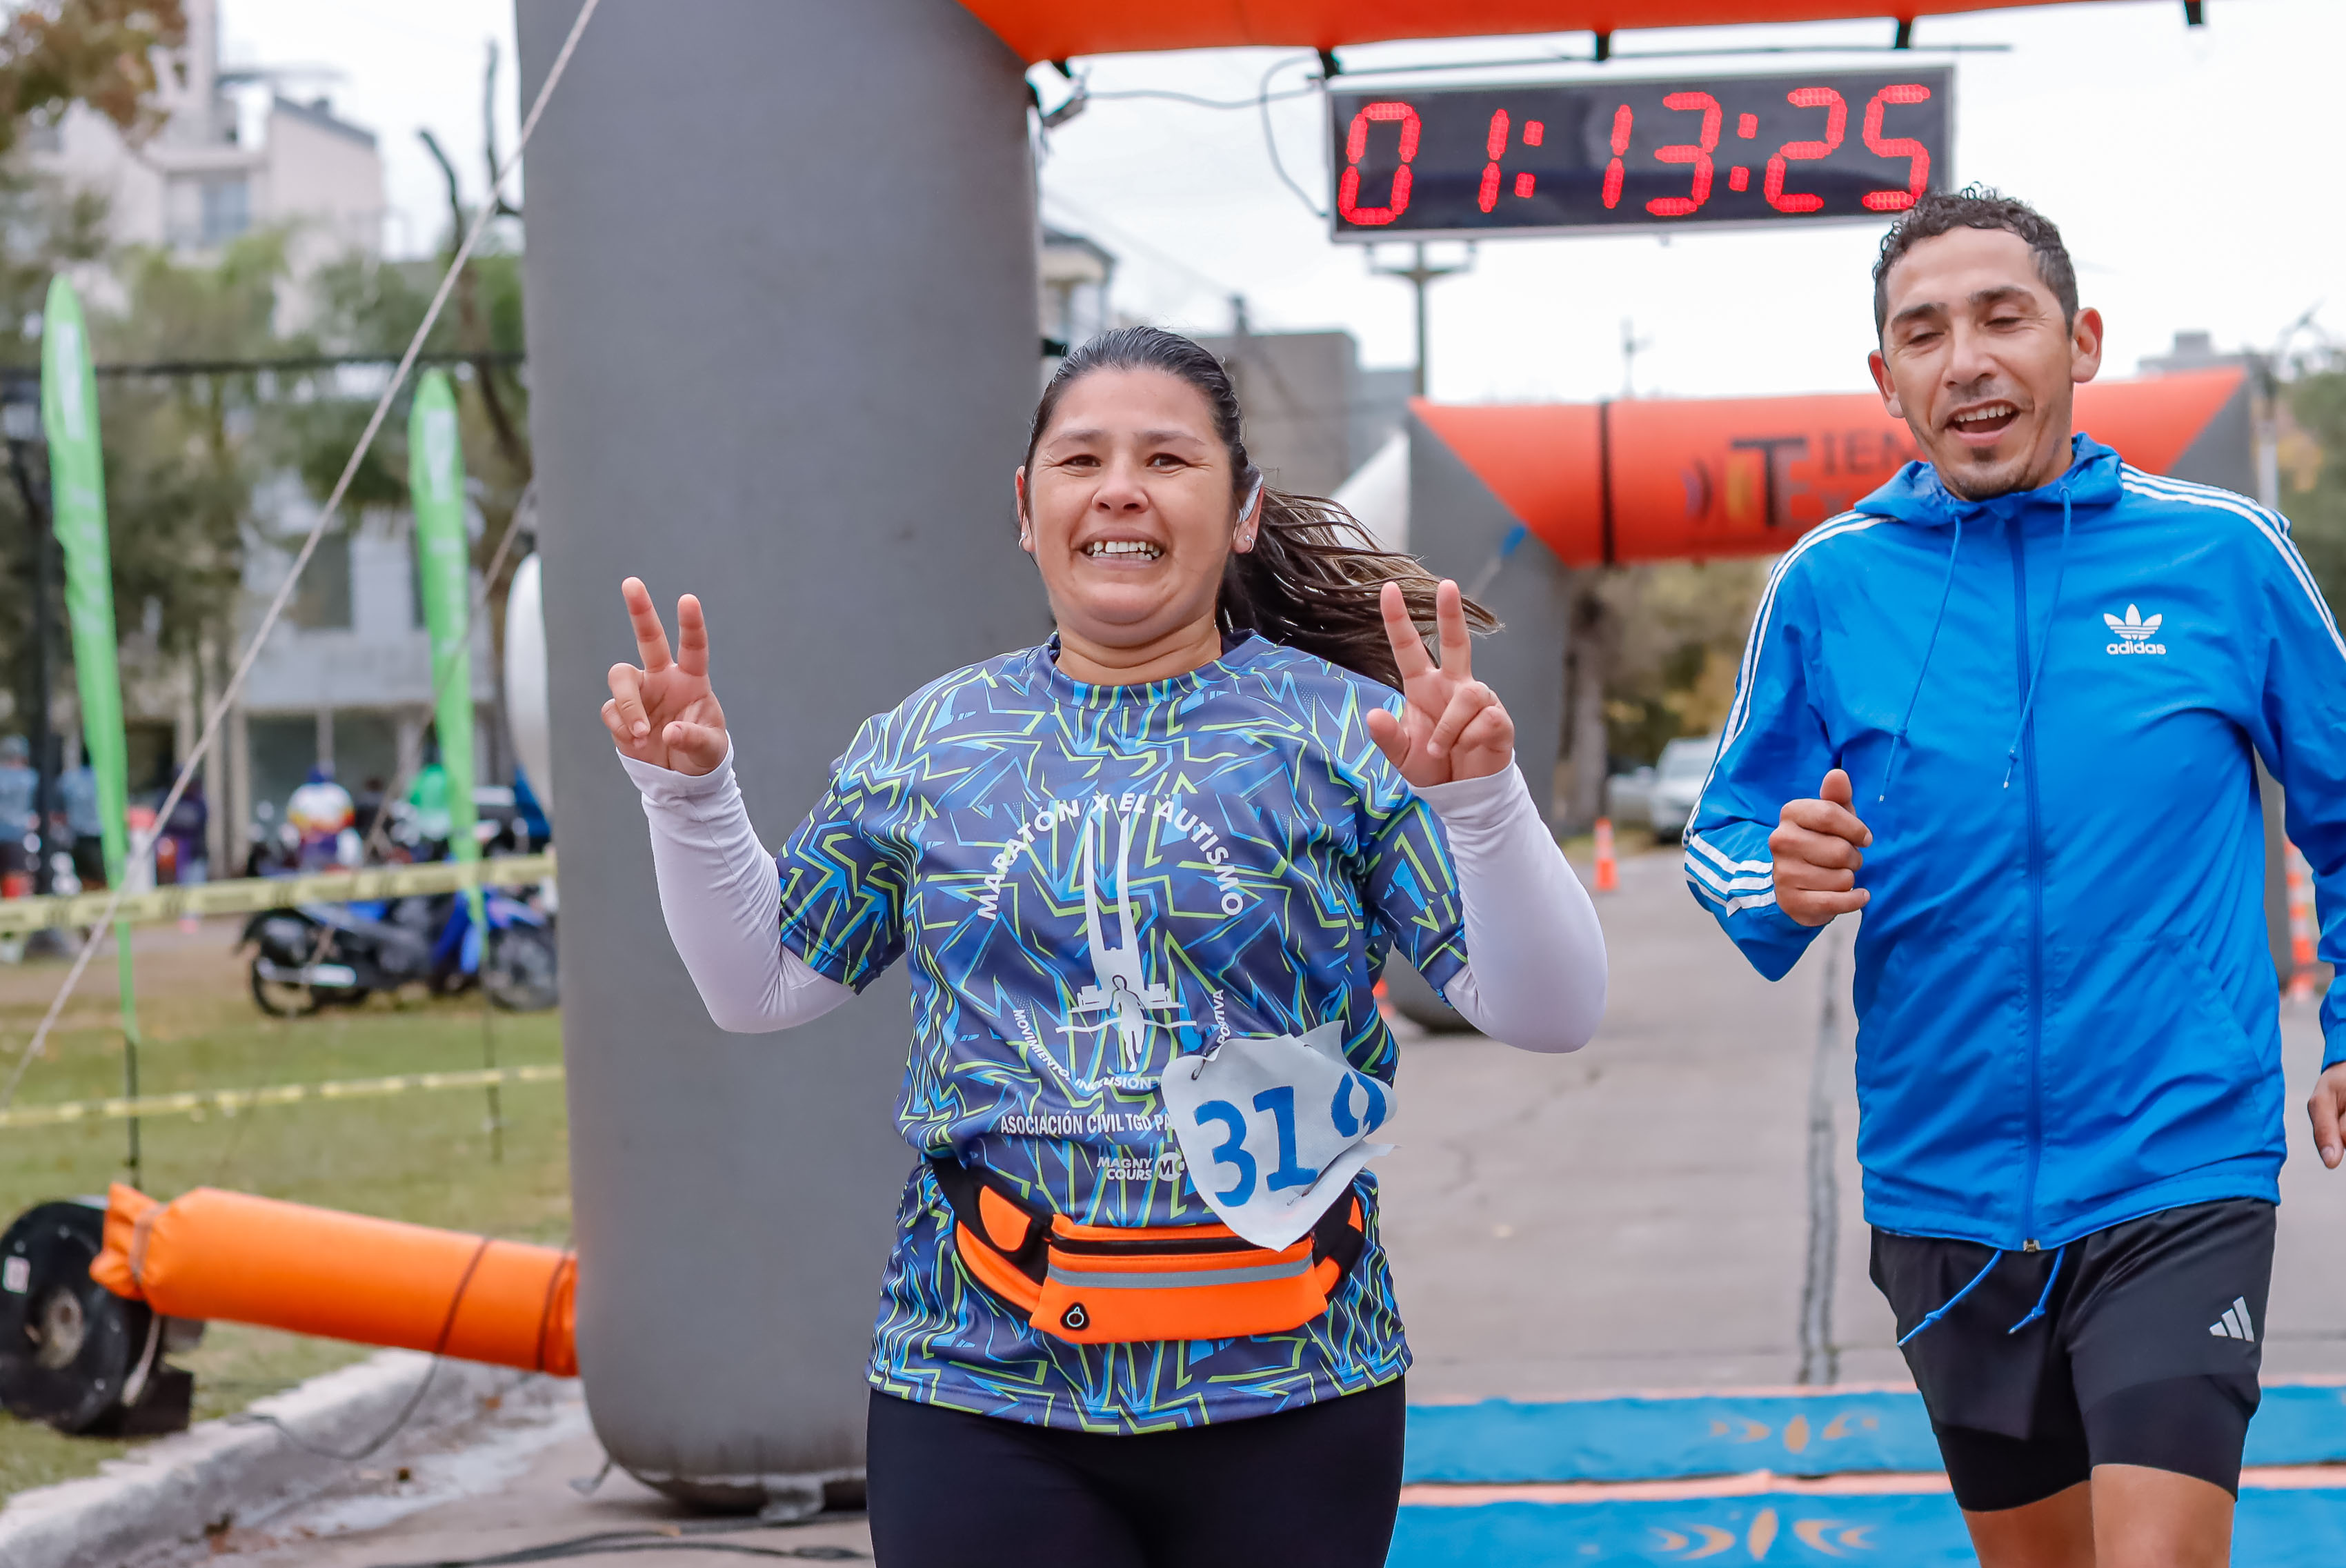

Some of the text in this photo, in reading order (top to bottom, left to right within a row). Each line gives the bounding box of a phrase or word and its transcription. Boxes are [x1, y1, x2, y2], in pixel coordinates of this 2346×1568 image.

[2106, 640, 2167, 655] adidas
[977, 793, 1244, 920] MARATÓN X EL AUTISMO
[1013, 1009, 1152, 1092] MOVIMIENTO, INCLUSIÓN
[1001, 1110, 1083, 1135] ASOCIACIÓN
[1086, 1113, 1125, 1134] CIVIL
[1125, 1113, 1153, 1131] TGD
[1097, 1156, 1153, 1169] MAGNY
[1106, 1169, 1153, 1181] COURS
